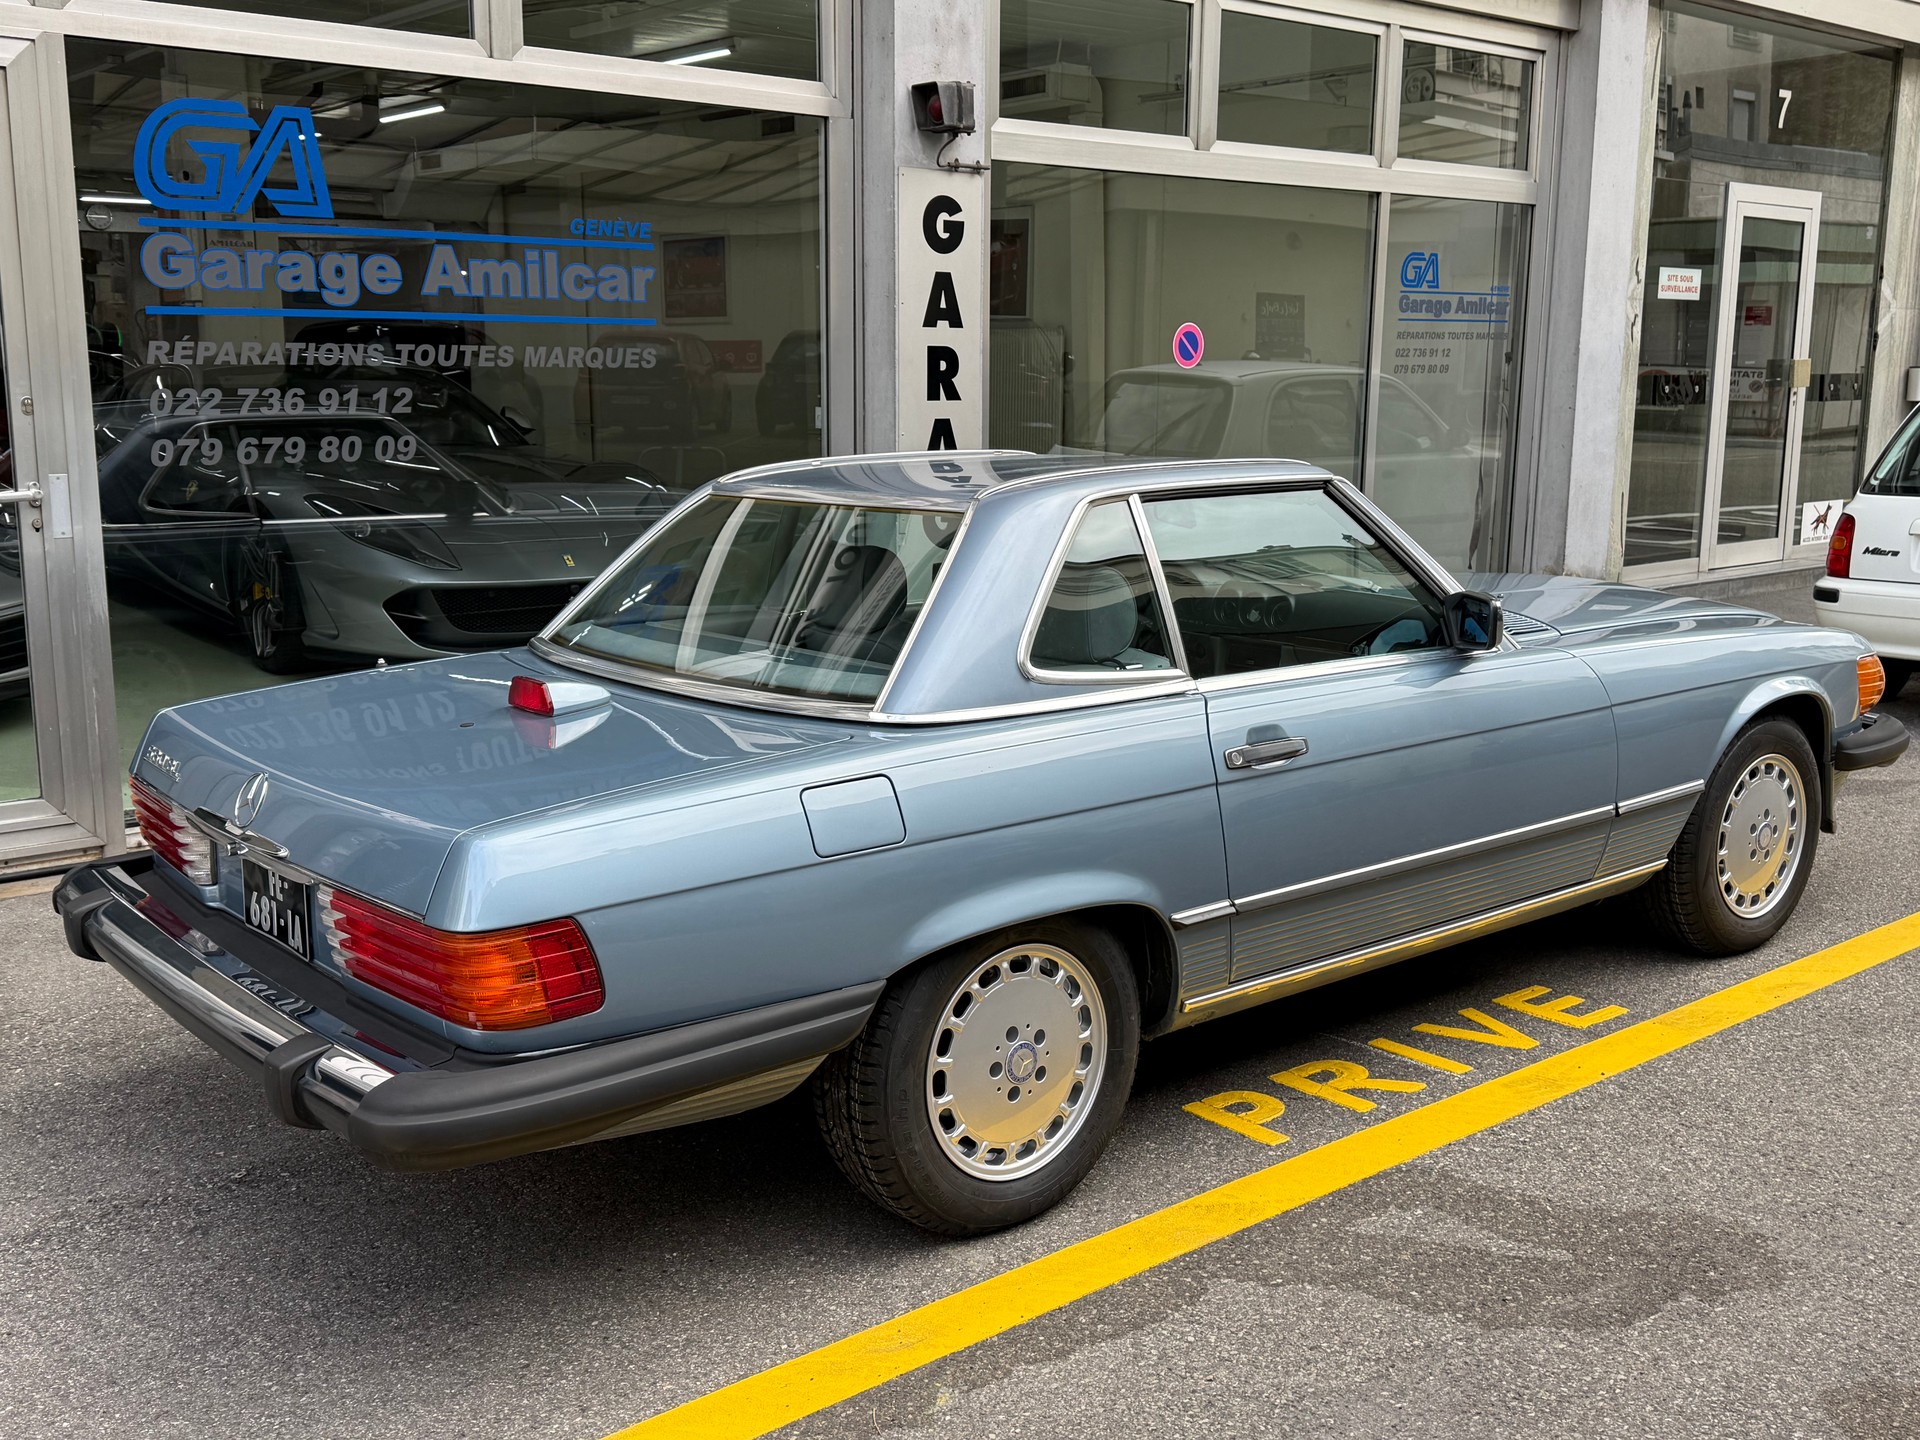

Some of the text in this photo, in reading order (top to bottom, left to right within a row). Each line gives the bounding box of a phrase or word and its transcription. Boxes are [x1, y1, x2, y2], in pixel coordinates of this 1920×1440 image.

[1778, 88, 1792, 128] 7
[570, 216, 652, 239] GENÈVE
[140, 231, 656, 307] Garage Amilcar
[1667, 274, 1694, 283] SITE SOUS
[1661, 284, 1698, 294] SURVEILLANCE
[1399, 295, 1510, 318] Garage Amilcar
[1397, 331, 1446, 340] RÉPARATIONS
[1448, 332, 1474, 340] TOUTES
[147, 336, 657, 370] RÉPARATIONS TOUTES MARQUES
[1395, 348, 1451, 357] 022 736 91 12
[1394, 365, 1449, 374] 079 679 80 09
[150, 387, 413, 416] 022 736 91 12
[150, 435, 418, 467] 079 679 80 09
[1182, 984, 1630, 1146] PRIVE
